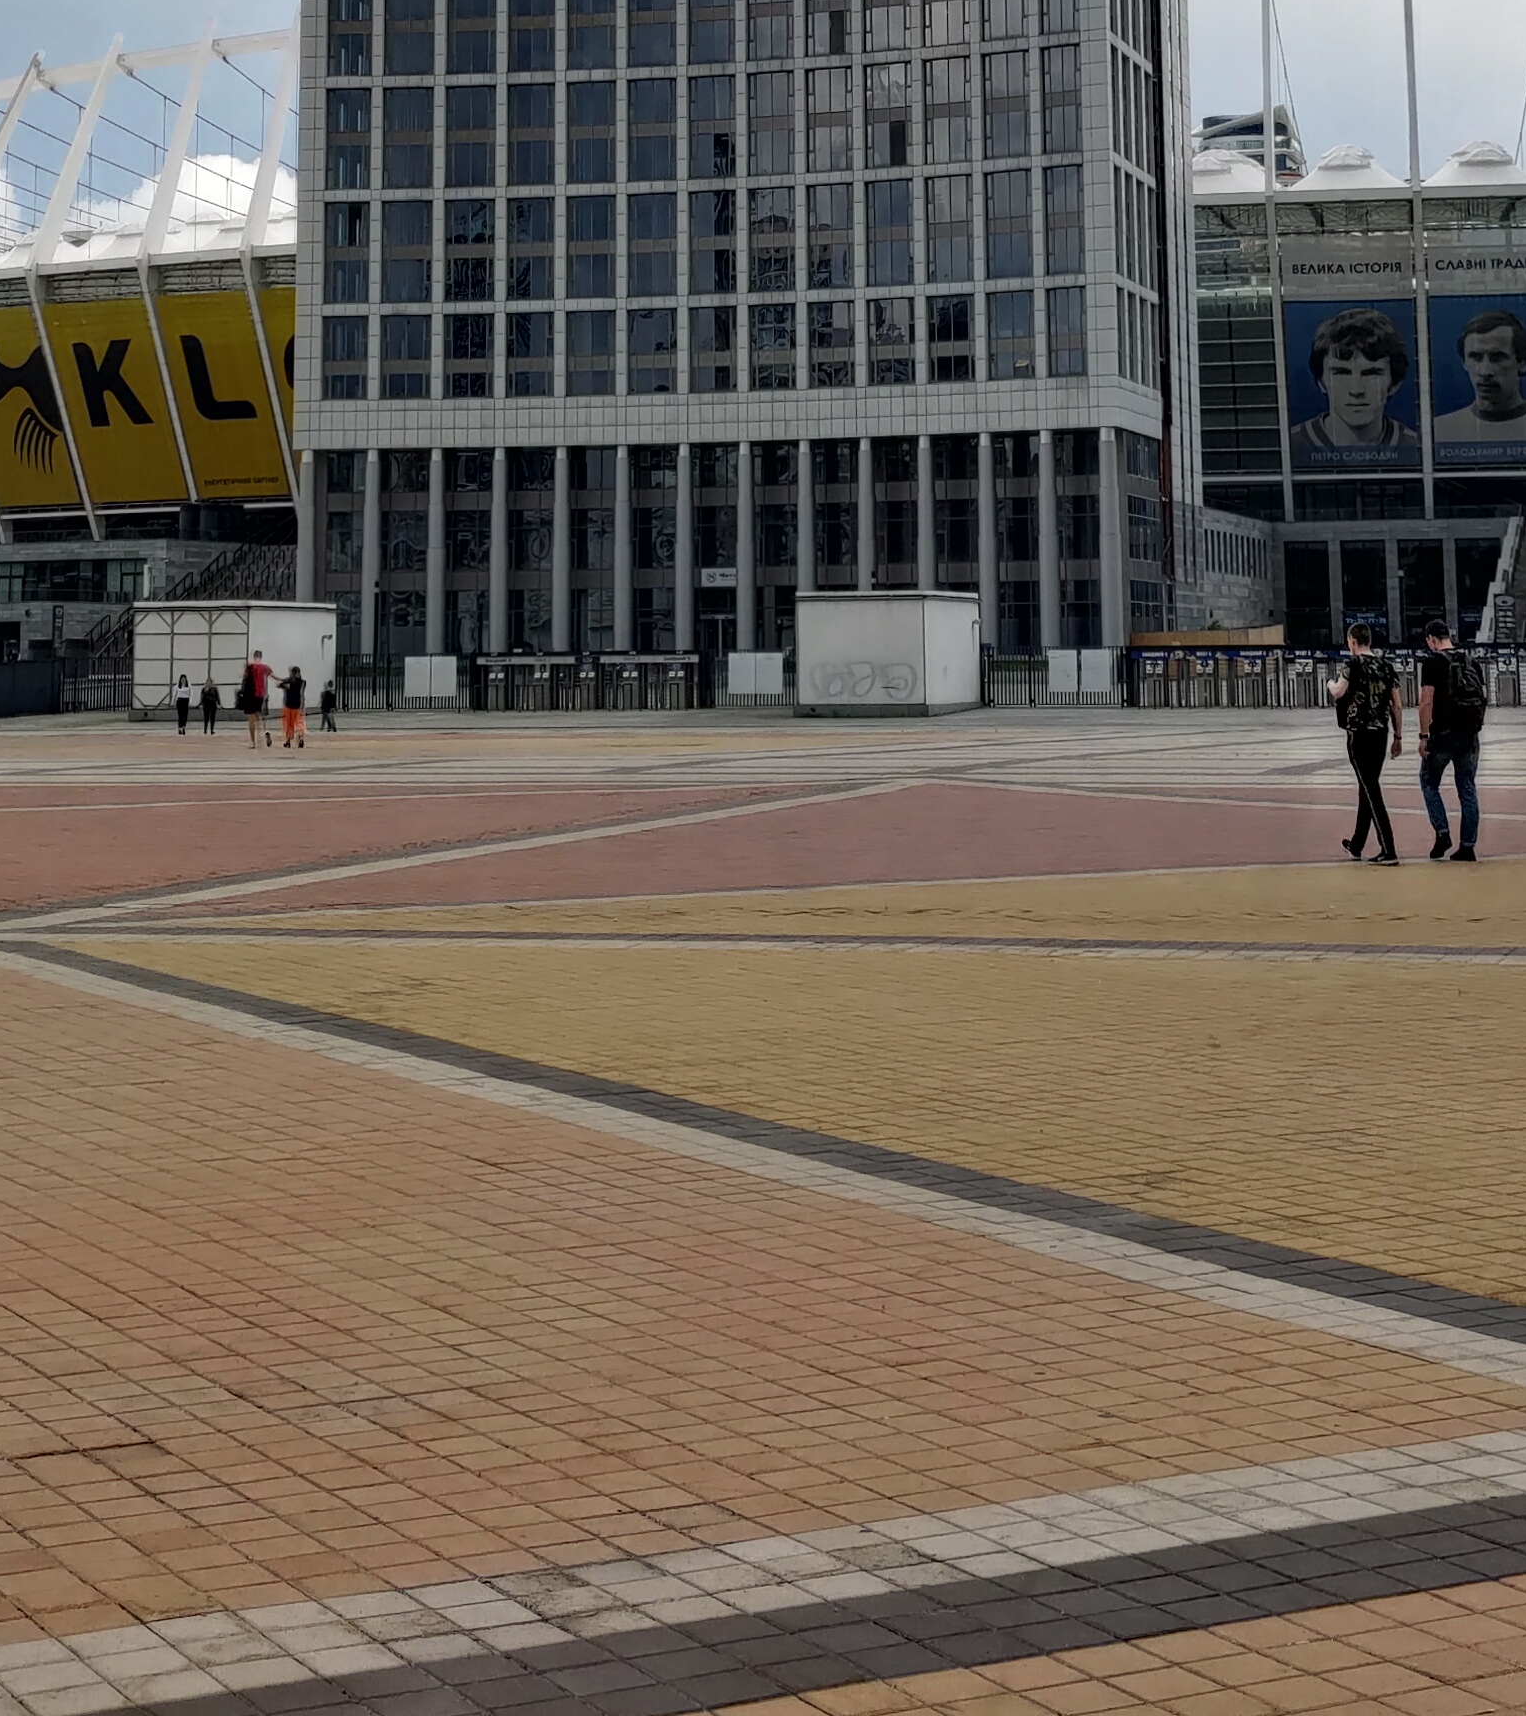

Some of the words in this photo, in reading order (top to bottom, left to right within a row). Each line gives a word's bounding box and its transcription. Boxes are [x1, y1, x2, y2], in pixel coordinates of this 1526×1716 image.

[1291, 262, 1345, 276] ВЕЛИКА
[1349, 261, 1402, 274] ІСТОРІЯ
[1435, 258, 1486, 272] СЛАВНІ
[71, 334, 295, 428] KL
[1311, 451, 1340, 461] ПЕТРО
[1342, 451, 1399, 461] СЛОБОДЯН
